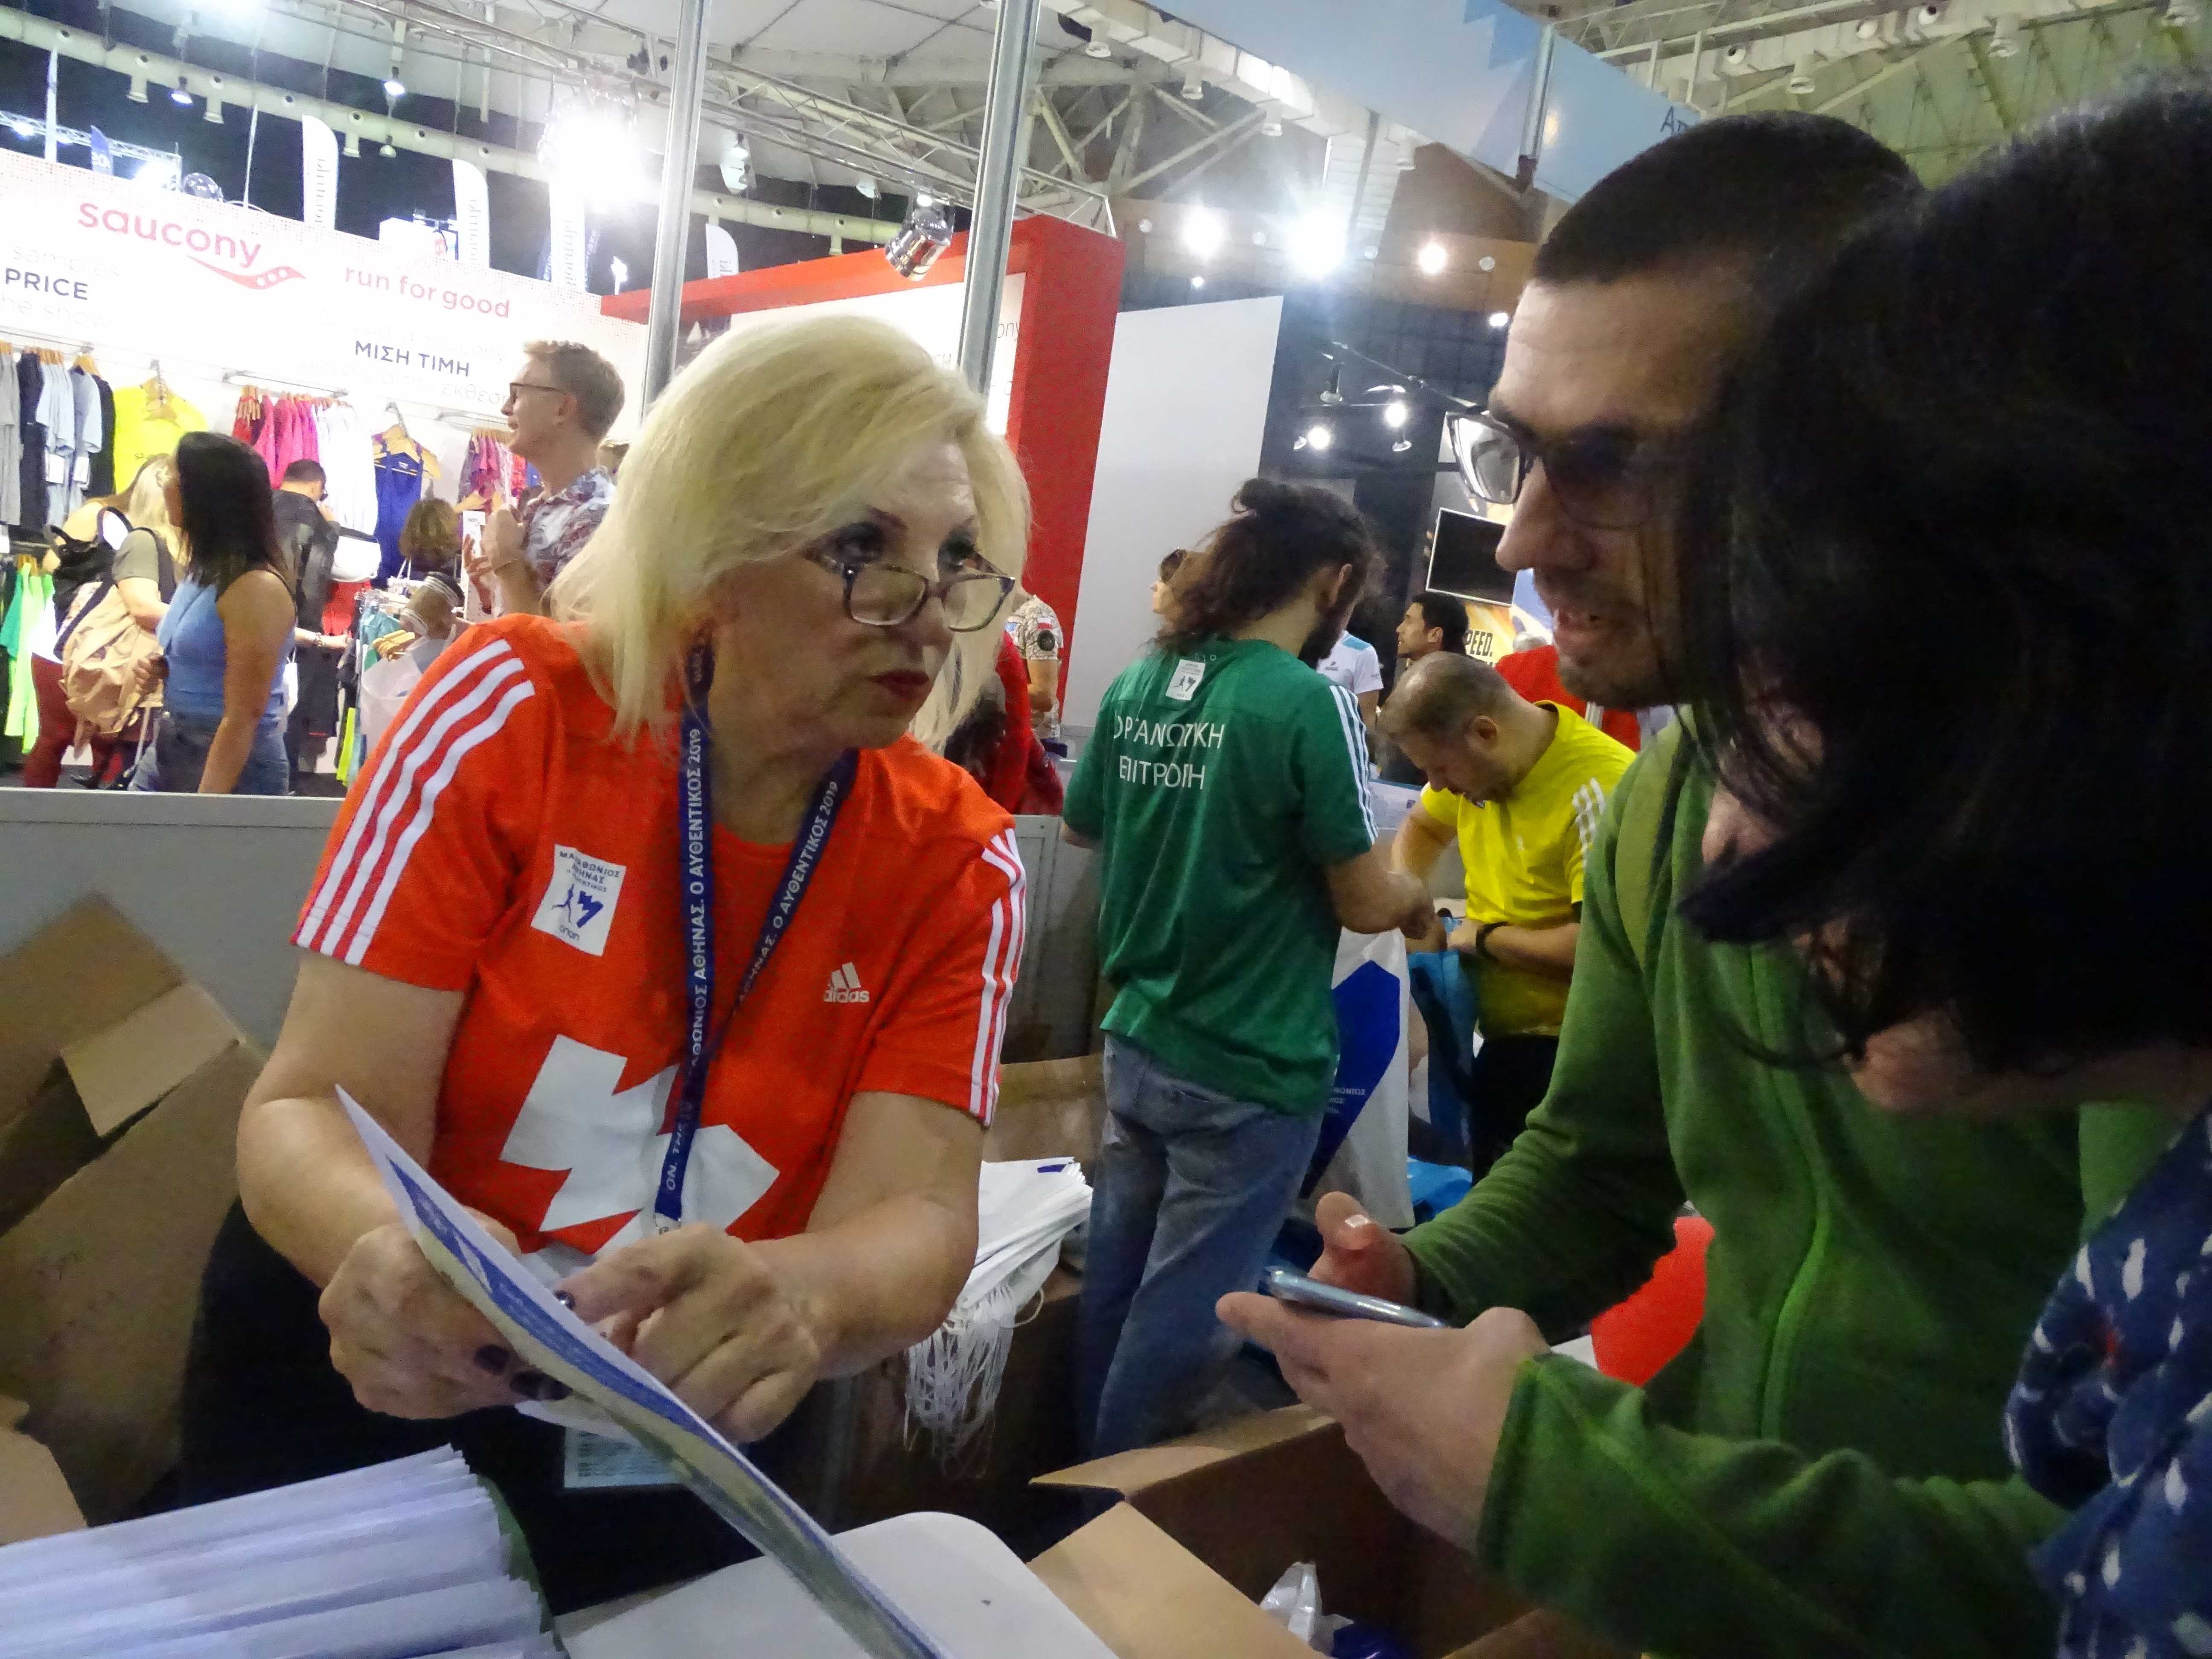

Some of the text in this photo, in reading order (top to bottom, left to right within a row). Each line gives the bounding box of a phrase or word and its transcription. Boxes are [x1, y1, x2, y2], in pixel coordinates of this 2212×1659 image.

[78, 203, 261, 268] saucony
[5, 267, 88, 301] PRICE
[346, 268, 509, 318] run for good
[2, 292, 32, 315] he
[355, 340, 469, 377] ΜΙΣΗ ΤΙΜΗ
[1463, 630, 1493, 657] PEED.
[688, 728, 701, 765] 2019
[819, 781, 838, 815] 2019
